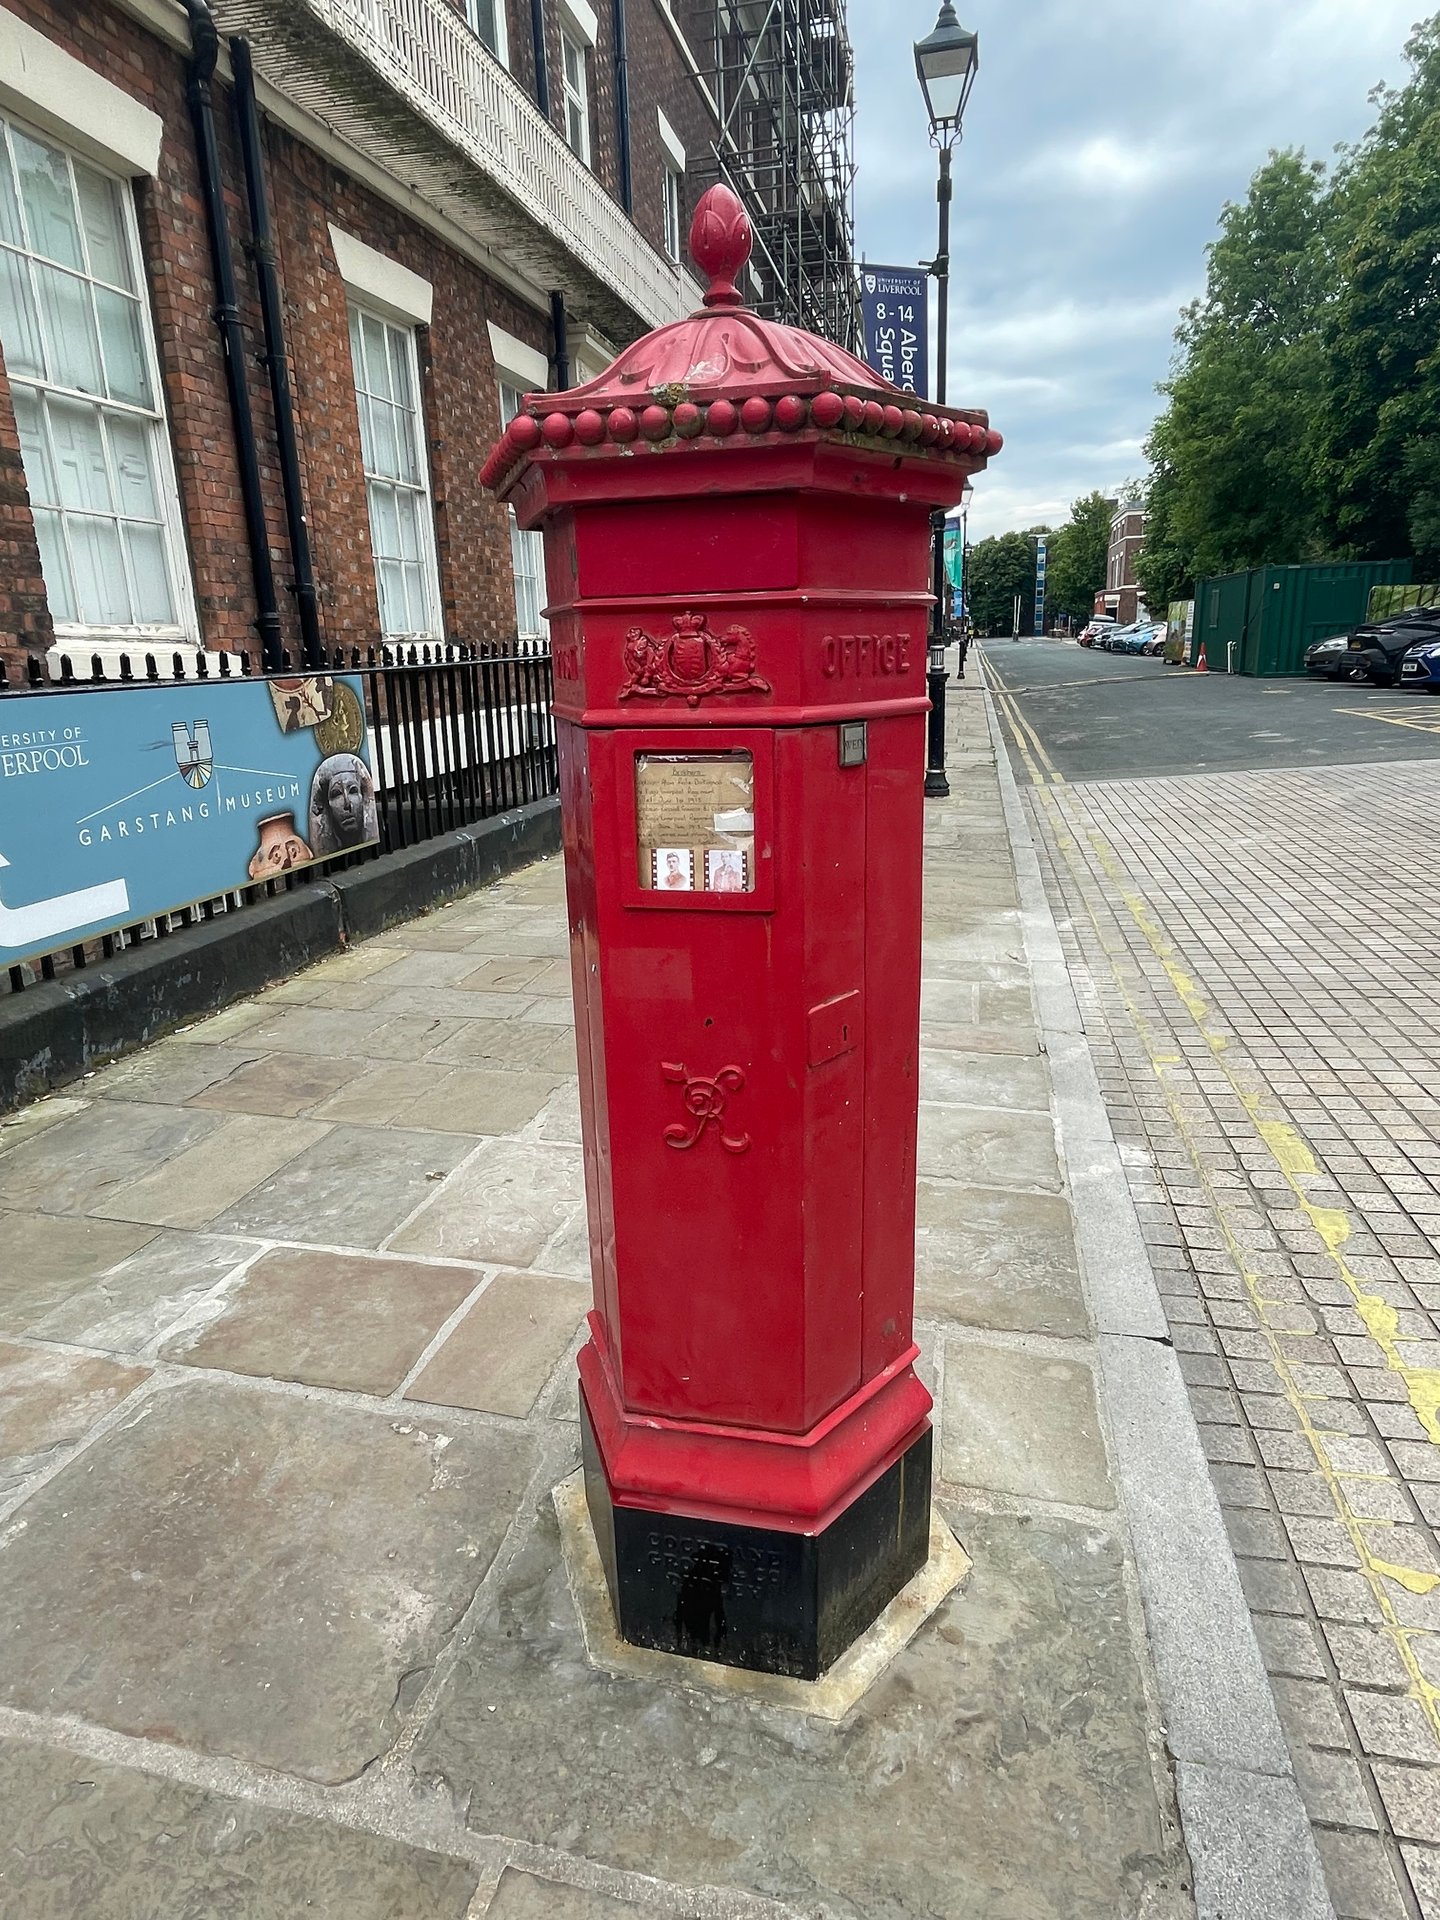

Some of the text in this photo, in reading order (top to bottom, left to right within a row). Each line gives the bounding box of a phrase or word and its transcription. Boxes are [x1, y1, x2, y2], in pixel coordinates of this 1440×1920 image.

[877, 277, 911, 285] UNIVERSITY
[877, 283, 922, 296] LIVERPOOL
[876, 302, 886, 320] 8
[897, 304, 915, 323] 14
[821, 633, 911, 678] OFFICE
[63, 727, 81, 740] OF
[79, 782, 300, 846] GARSTANG MUSEUM
